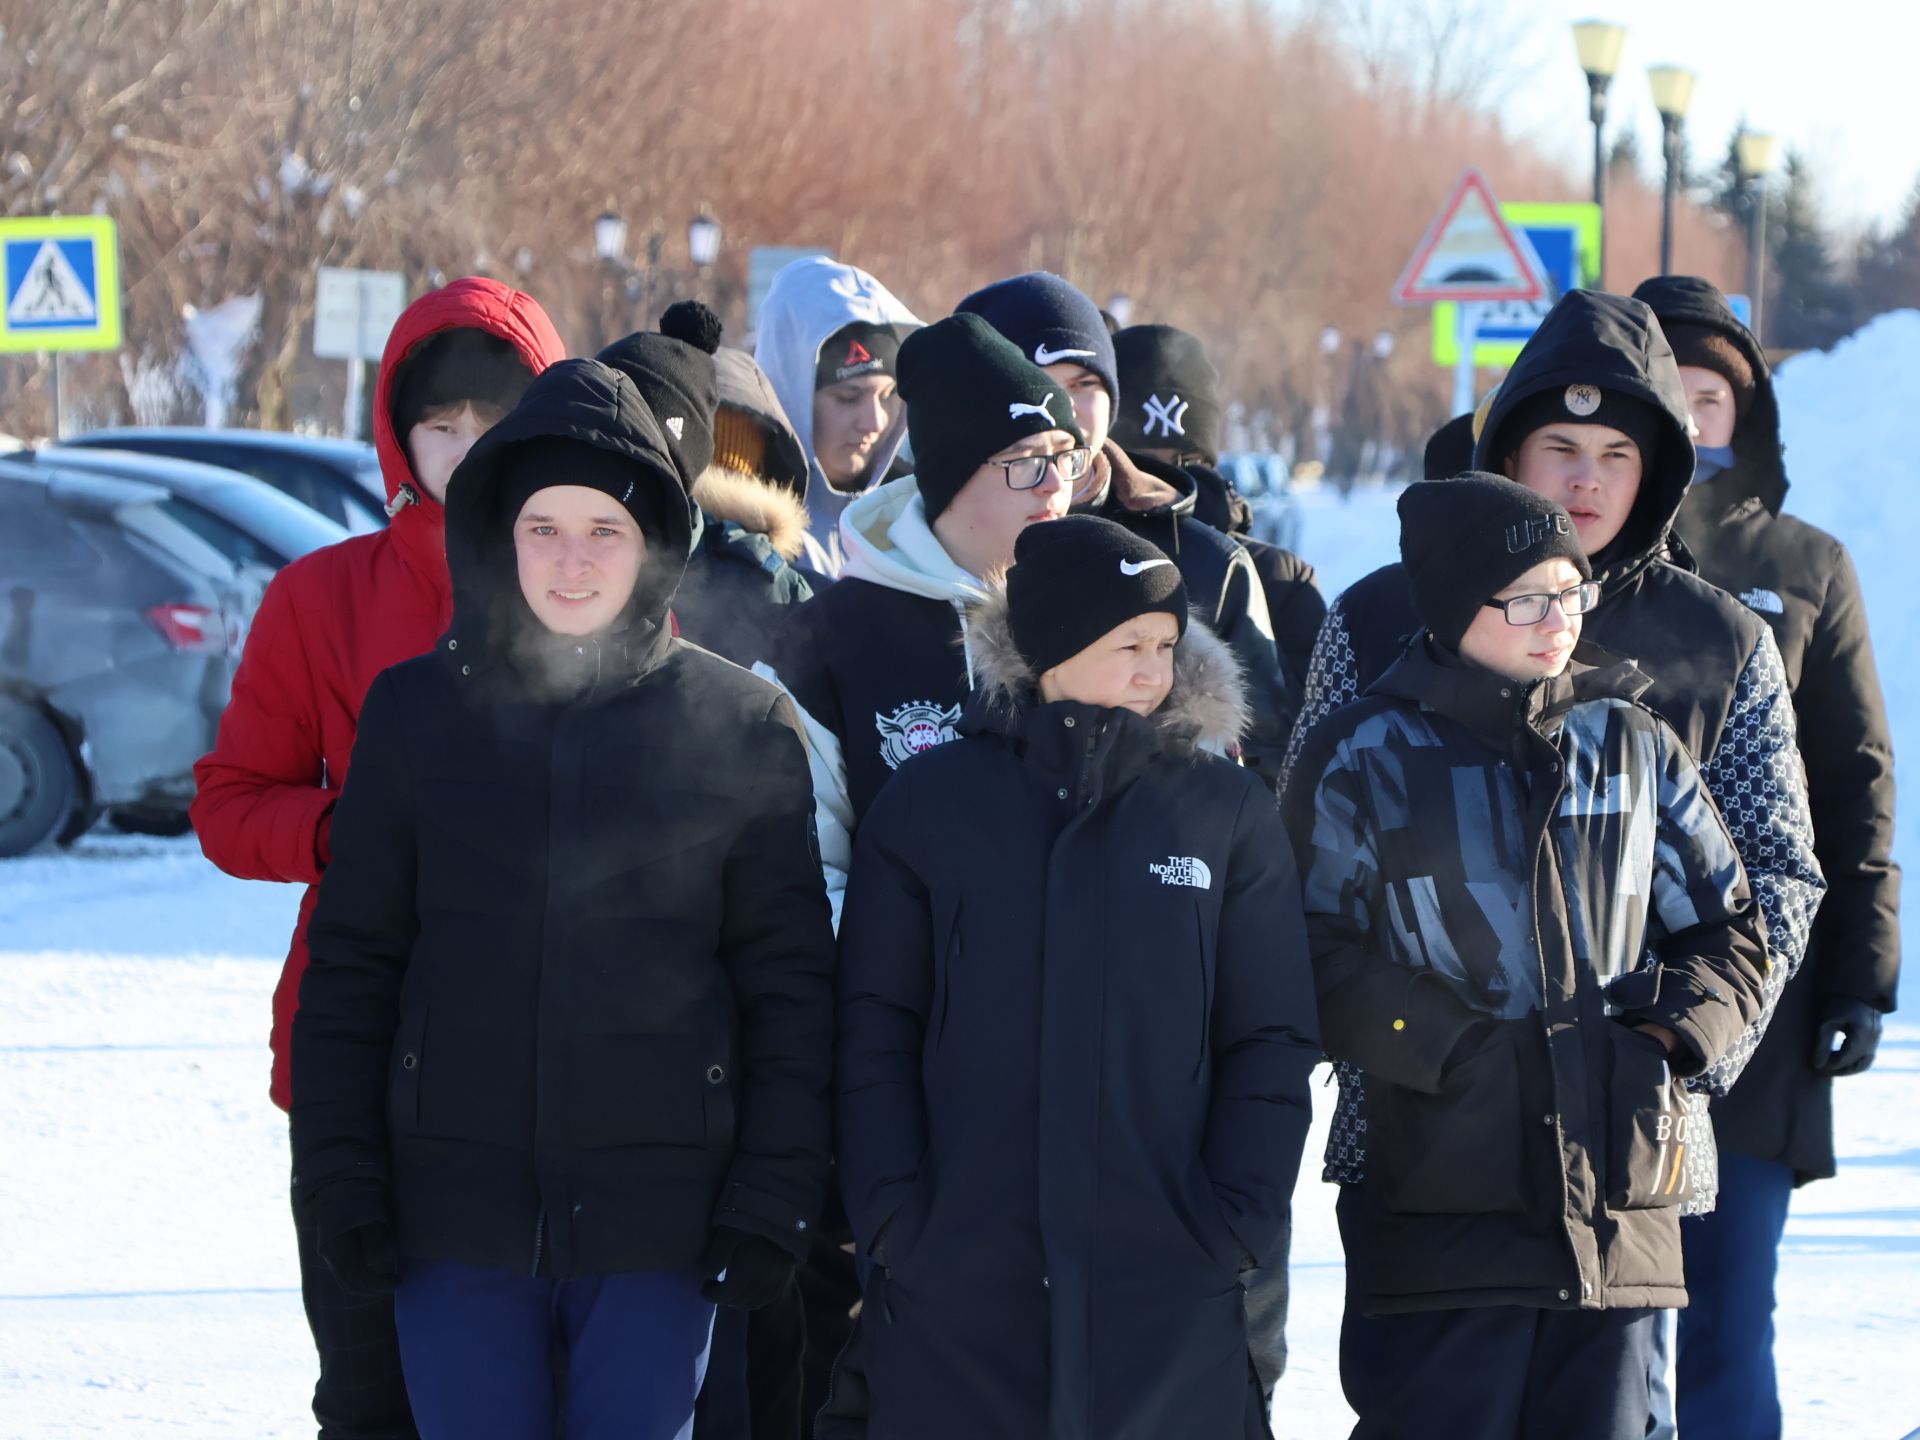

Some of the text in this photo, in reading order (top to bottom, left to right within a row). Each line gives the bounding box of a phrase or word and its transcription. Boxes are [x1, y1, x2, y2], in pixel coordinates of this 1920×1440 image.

[1142, 393, 1189, 437] NY
[1505, 514, 1570, 554] UFC
[1168, 856, 1192, 867] THE
[1149, 863, 1192, 876] NORTH
[1161, 874, 1192, 886] FACE
